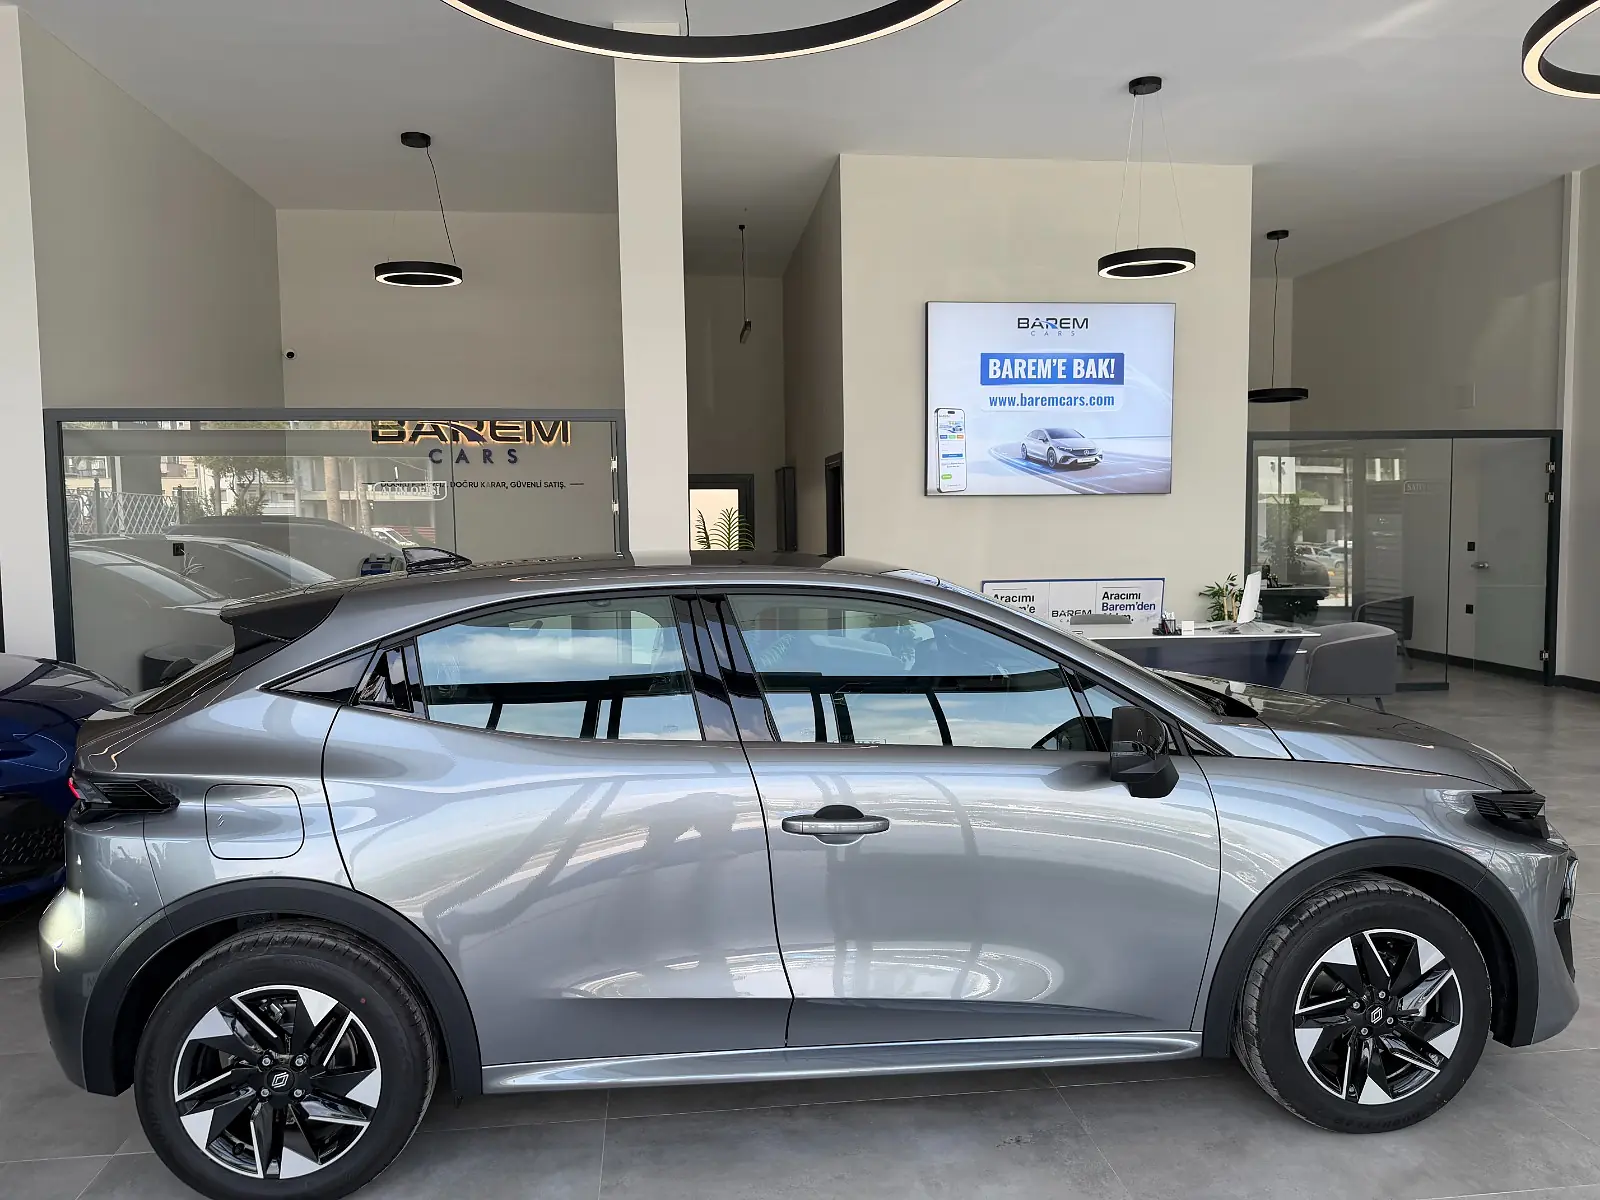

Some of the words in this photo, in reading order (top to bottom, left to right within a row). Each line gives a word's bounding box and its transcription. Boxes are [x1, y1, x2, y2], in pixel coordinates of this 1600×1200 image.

[1017, 317, 1089, 329] BAREM
[988, 358, 1067, 379] BAREM'E
[1072, 358, 1116, 379] BAK!
[989, 393, 1115, 407] www.baremcars.com
[371, 420, 571, 444] BAREM
[428, 448, 519, 464] CARS
[450, 479, 479, 488] DOĞRU
[509, 479, 542, 488] GÜVENLİ
[543, 481, 567, 490] SATIŞ.
[1101, 591, 1142, 601] Aracımı
[1101, 601, 1156, 612] Barem'den
